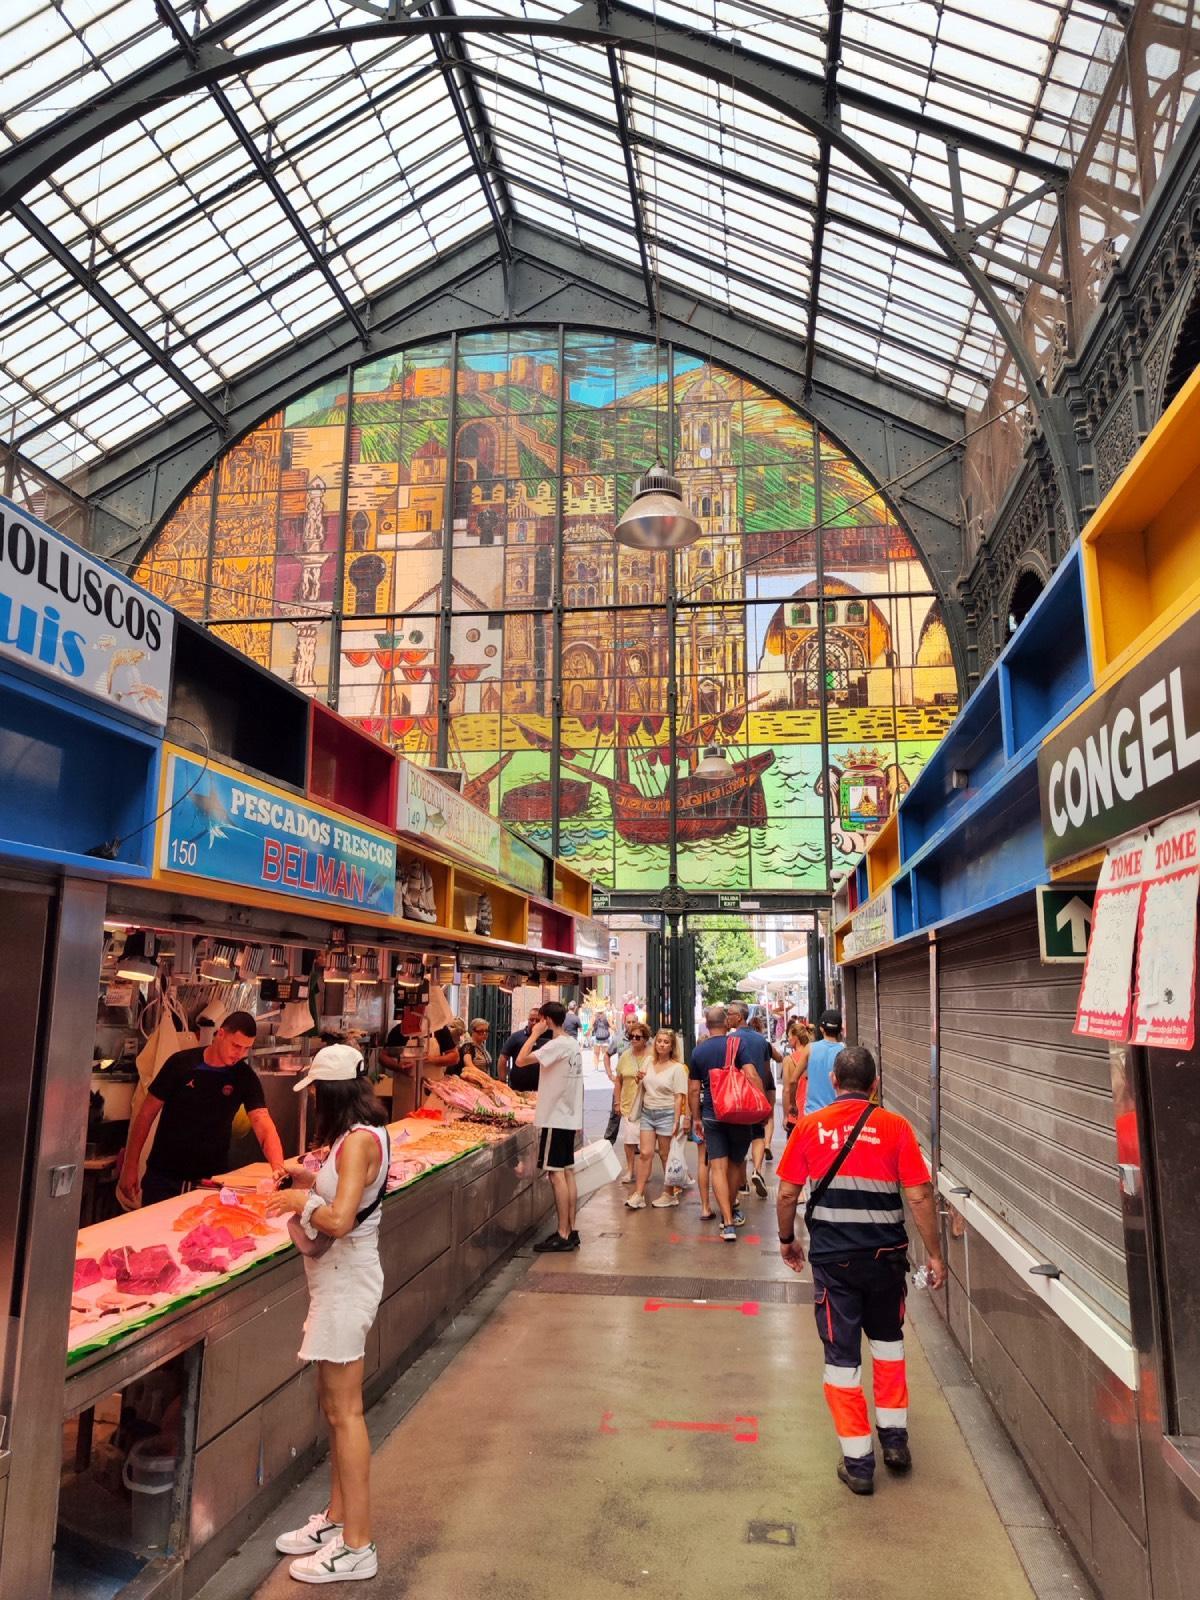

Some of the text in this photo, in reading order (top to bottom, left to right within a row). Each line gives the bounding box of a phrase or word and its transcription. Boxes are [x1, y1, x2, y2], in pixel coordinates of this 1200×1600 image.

[0, 512, 161, 652] OLUSCOS
[171, 838, 197, 866] 150
[231, 787, 393, 869] PESCADOS FRESCOS
[1155, 829, 1197, 870] TOME
[261, 837, 366, 902] BELMAN
[1109, 849, 1143, 882] TOME
